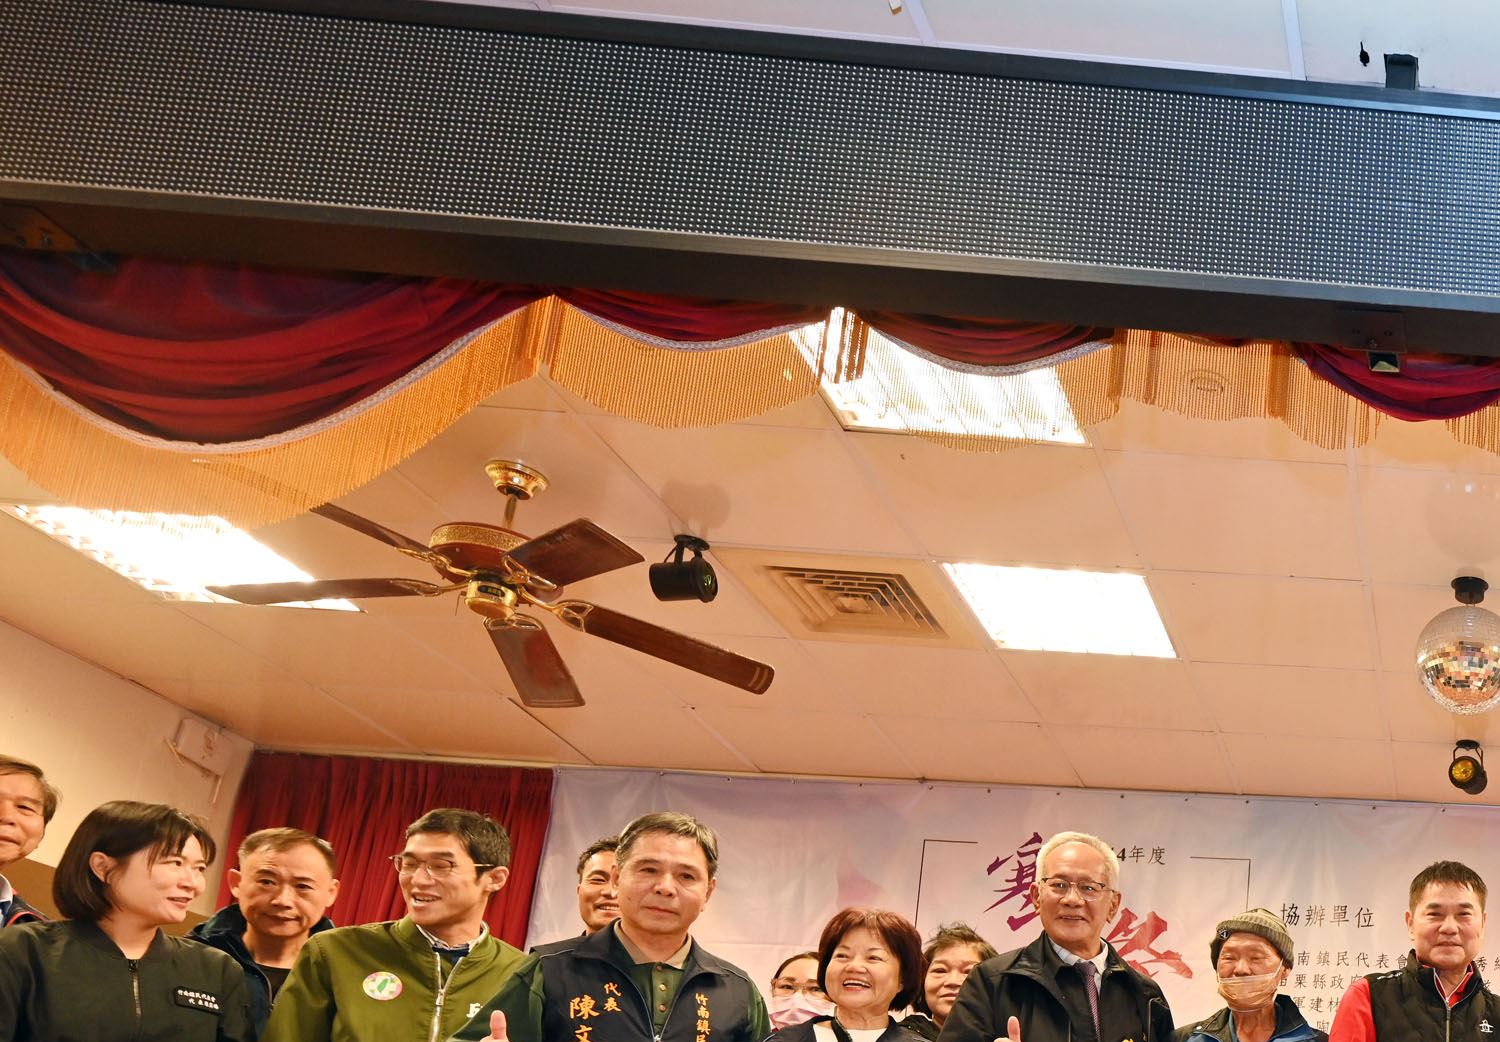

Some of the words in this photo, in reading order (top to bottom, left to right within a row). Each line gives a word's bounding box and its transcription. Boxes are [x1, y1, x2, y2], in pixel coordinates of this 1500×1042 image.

[1280, 903, 1375, 928] 協辦單位
[603, 982, 622, 1012] 代表
